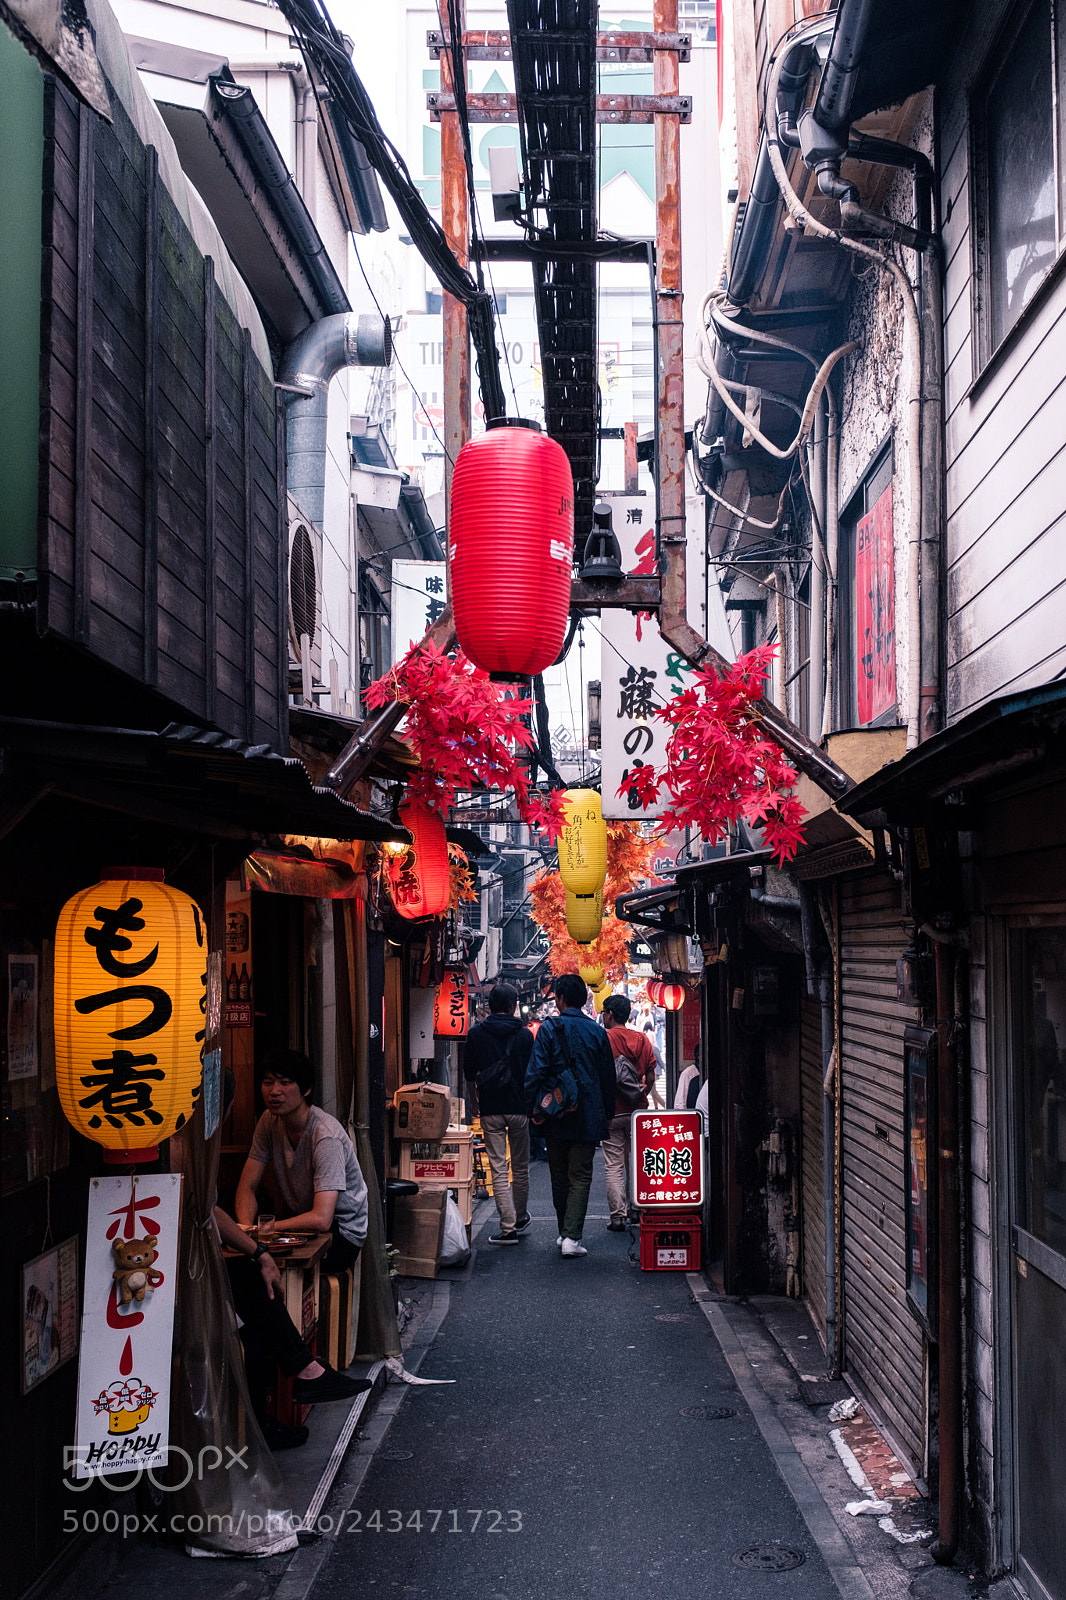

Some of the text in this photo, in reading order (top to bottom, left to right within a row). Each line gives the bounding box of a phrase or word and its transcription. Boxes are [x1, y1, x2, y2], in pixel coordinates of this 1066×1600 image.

[626, 508, 643, 525] 清
[450, 972, 466, 1034] やきとり
[75, 897, 173, 1129] もつ煮
[642, 1118, 662, 1130] 珍品
[651, 1123, 684, 1138] スタミナ
[674, 1131, 694, 1143] 料理
[415, 1163, 454, 1171] アサヒビール
[140, 1391, 153, 1399] ゼロ
